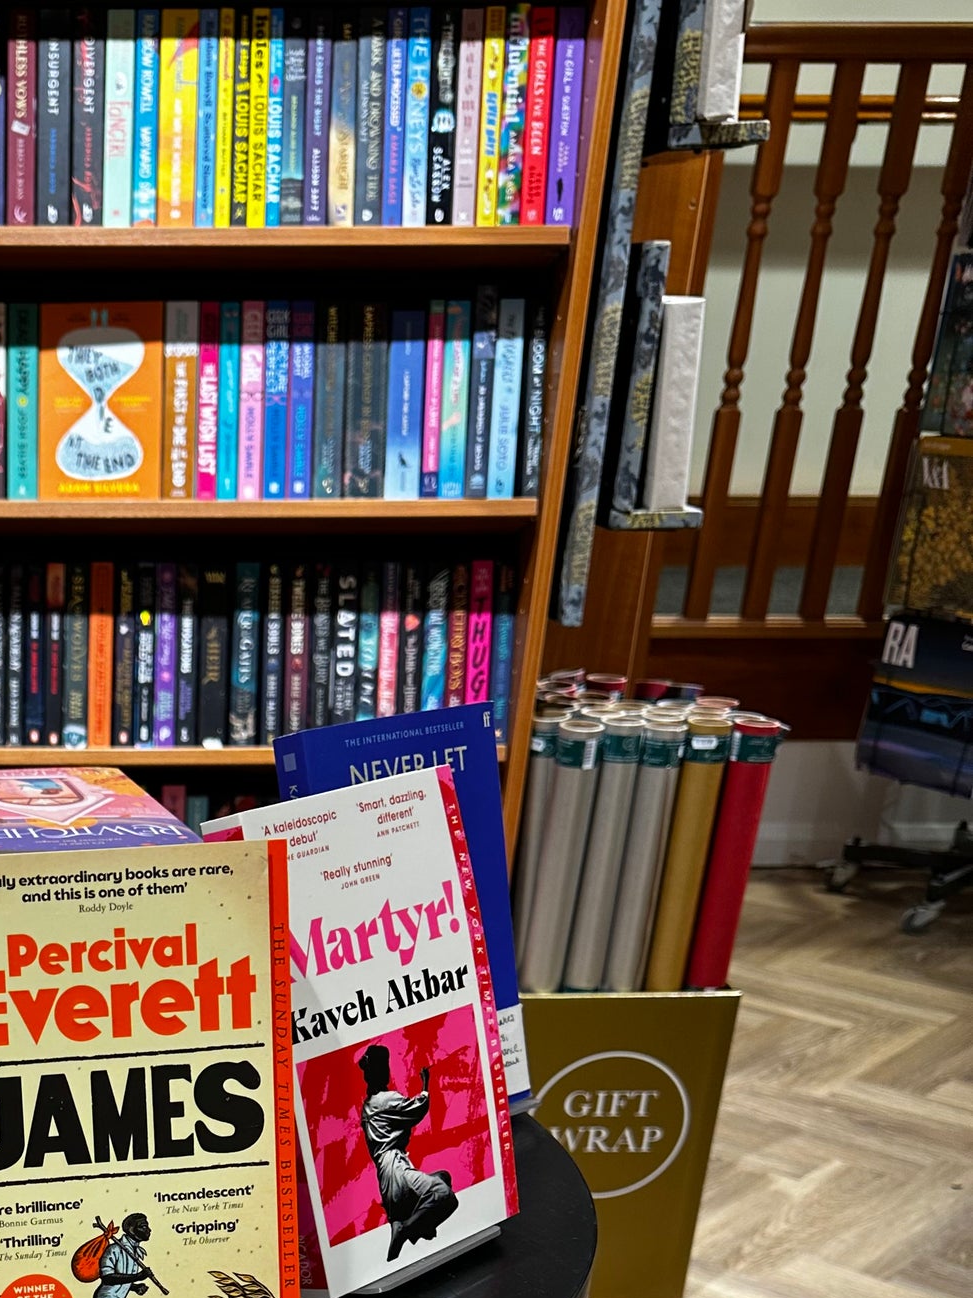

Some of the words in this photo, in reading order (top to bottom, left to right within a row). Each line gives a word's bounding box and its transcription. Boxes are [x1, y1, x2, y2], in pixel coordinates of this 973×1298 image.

[67, 346, 103, 365] THEY
[85, 362, 121, 383] BOTH
[77, 451, 100, 471] THE
[103, 453, 136, 474] END
[336, 575, 358, 677] SLATED
[482, 711, 491, 729] ff
[345, 739, 361, 748] THE
[362, 728, 423, 745] INTERNATIONAL
[425, 721, 464, 735] BESTSELLER
[349, 753, 426, 785] NEVER
[273, 810, 337, 834] kaleidoscopic
[377, 806, 414, 825] different’
[289, 830, 318, 848] debut’
[376, 829, 390, 838] ANN
[391, 821, 420, 835] PATCHETT
[296, 845, 330, 860] GUARDIAN
[18, 867, 123, 887] extraordinary
[125, 866, 169, 880] books
[171, 865, 197, 877] are
[199, 863, 234, 876] rare,
[320, 867, 351, 883] ‘Really
[353, 852, 393, 874] stunning’
[21, 889, 51, 903] and
[54, 886, 82, 901] this
[84, 885, 96, 899] is
[98, 887, 125, 899] one
[128, 882, 144, 896] of
[146, 880, 188, 896] them’
[341, 880, 355, 890] JOHN
[357, 874, 381, 887] GREEN
[78, 902, 106, 914] Roddy
[109, 901, 133, 913] Doyle
[289, 880, 461, 984] Martyr!
[6, 923, 198, 977] Percival
[272, 923, 285, 966] THE
[448, 803, 464, 837] THE
[458, 852, 473, 890] NEW
[469, 905, 484, 954] YORK
[480, 969, 494, 1026] TIMES
[490, 1039, 511, 1151] BESTSELLER
[291, 989, 377, 1045] Kaveh
[385, 964, 468, 1014] Akbar
[273, 979, 290, 1068] SUNDAY
[277, 1082, 291, 1147] TIMES
[563, 1089, 659, 1118] GIFT
[549, 1125, 664, 1153] WRAP
[154, 1184, 254, 1204] ‘Incandescent’
[17, 1198, 84, 1215] brilliance’
[166, 1204, 180, 1215] The
[182, 1203, 200, 1213] New
[202, 1202, 220, 1212] York
[222, 1201, 244, 1211] Times
[29, 1215, 63, 1227] Garmus
[171, 1219, 239, 1236] ‘Gripping’
[281, 1159, 296, 1288] BESTSELLER
[0, 1233, 64, 1251] ‘Thrilling’
[183, 1236, 197, 1246] The
[198, 1234, 230, 1246] Observer
[15, 1250, 43, 1263] Sunday
[46, 1248, 67, 1259] Times
[13, 1284, 56, 1295] WINNER
